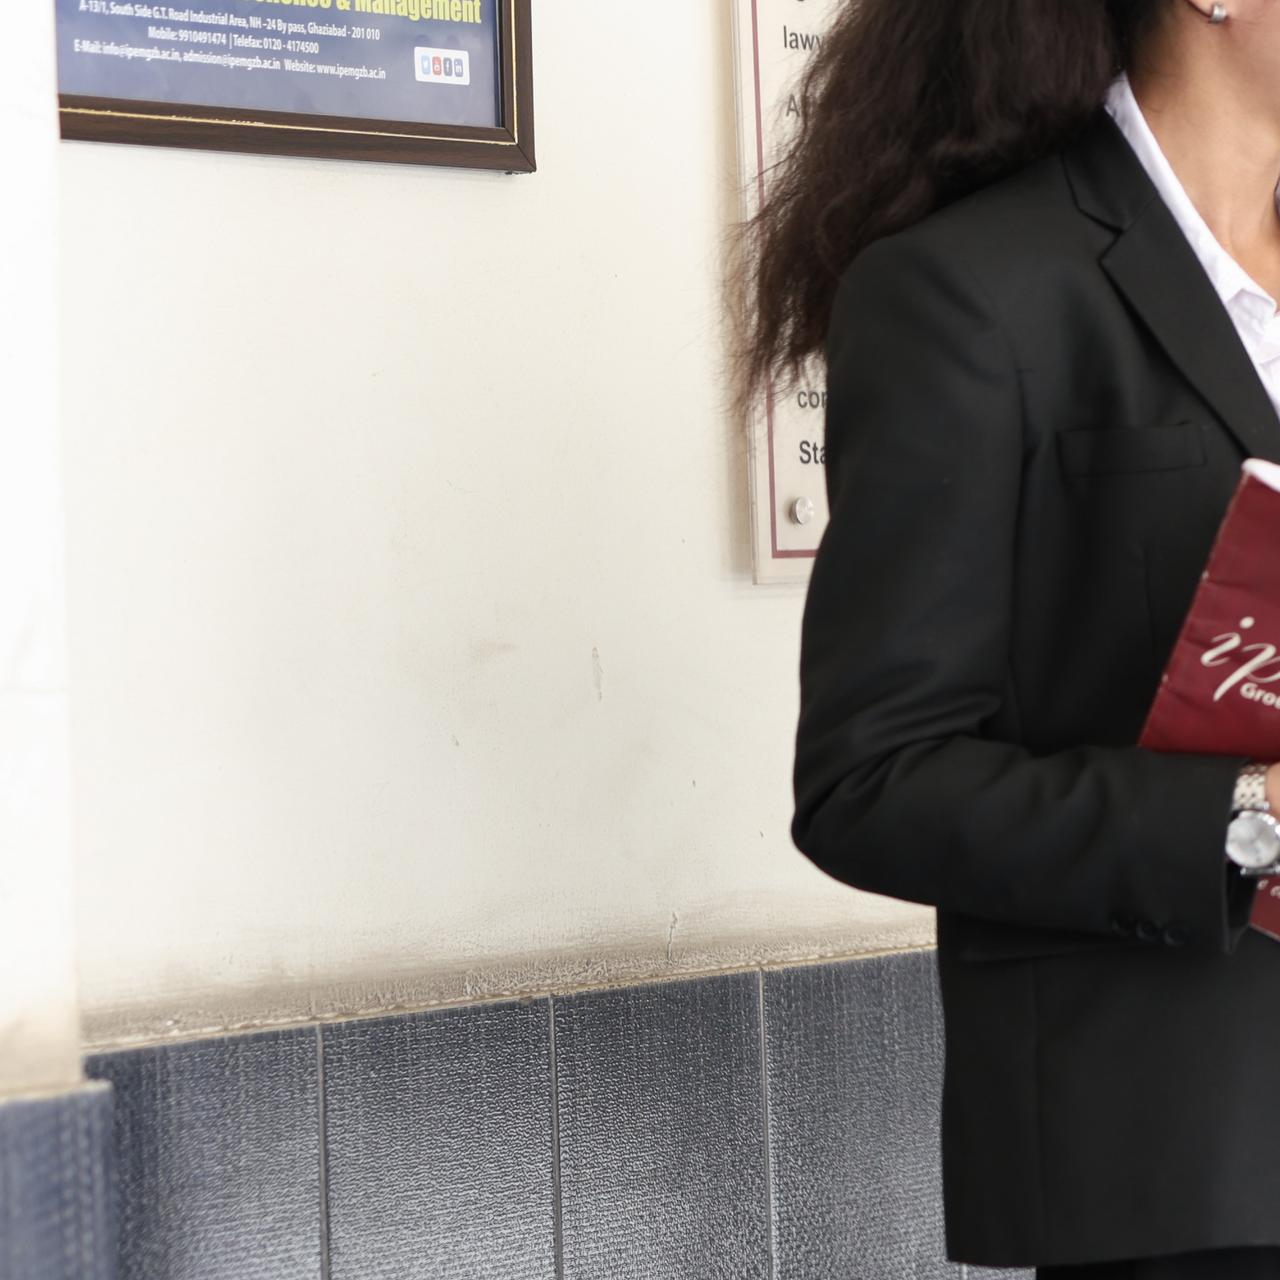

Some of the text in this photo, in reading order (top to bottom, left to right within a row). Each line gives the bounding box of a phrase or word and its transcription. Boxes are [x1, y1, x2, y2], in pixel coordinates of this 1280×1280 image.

[109, 1, 134, 17] South
[134, 4, 152, 18] Side
[168, 8, 189, 22] Road
[190, 10, 228, 25] Industrial
[249, 16, 262, 29] NH
[277, 19, 287, 34] By
[307, 22, 346, 37] Ghaziabad
[352, 27, 365, 39] 201
[366, 29, 381, 41] 010
[178, 29, 227, 45] 9910491474
[263, 37, 281, 50] 0120
[287, 41, 319, 54] 4174500
[316, 63, 386, 80] www.ipemgzb.ac.in
